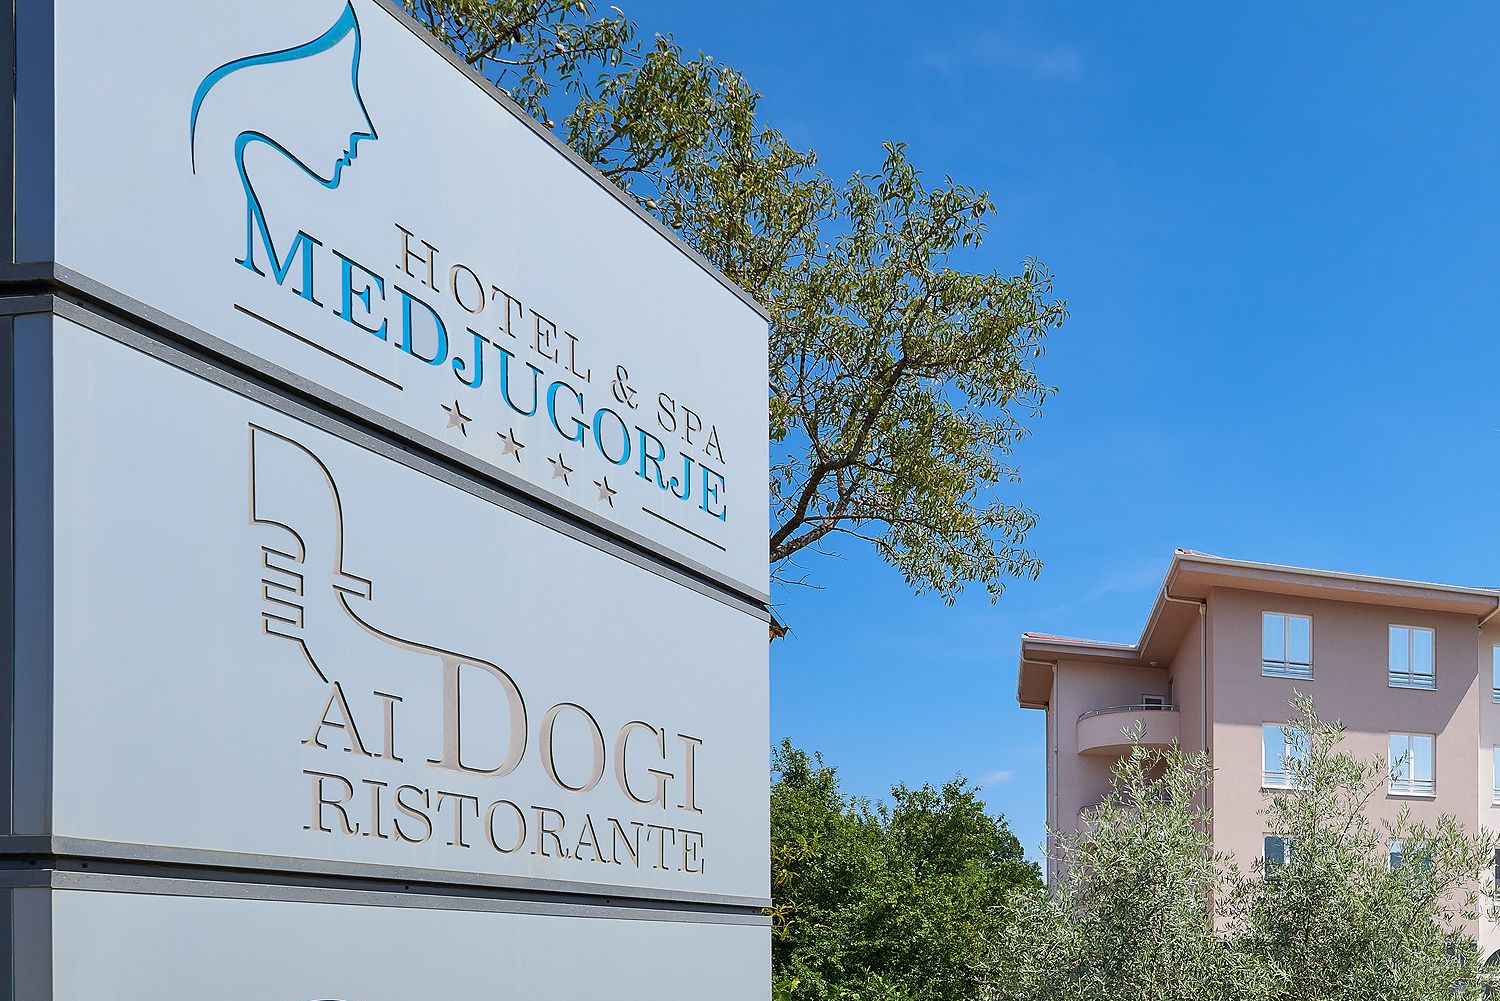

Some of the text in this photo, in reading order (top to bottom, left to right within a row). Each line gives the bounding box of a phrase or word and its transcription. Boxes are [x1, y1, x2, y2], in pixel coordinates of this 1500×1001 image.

[234, 204, 728, 522] MEDJUGORJE
[395, 223, 727, 464] HOTEL & SPA
[301, 653, 704, 815] AI DOGI
[302, 770, 706, 876] RISTORANTE
